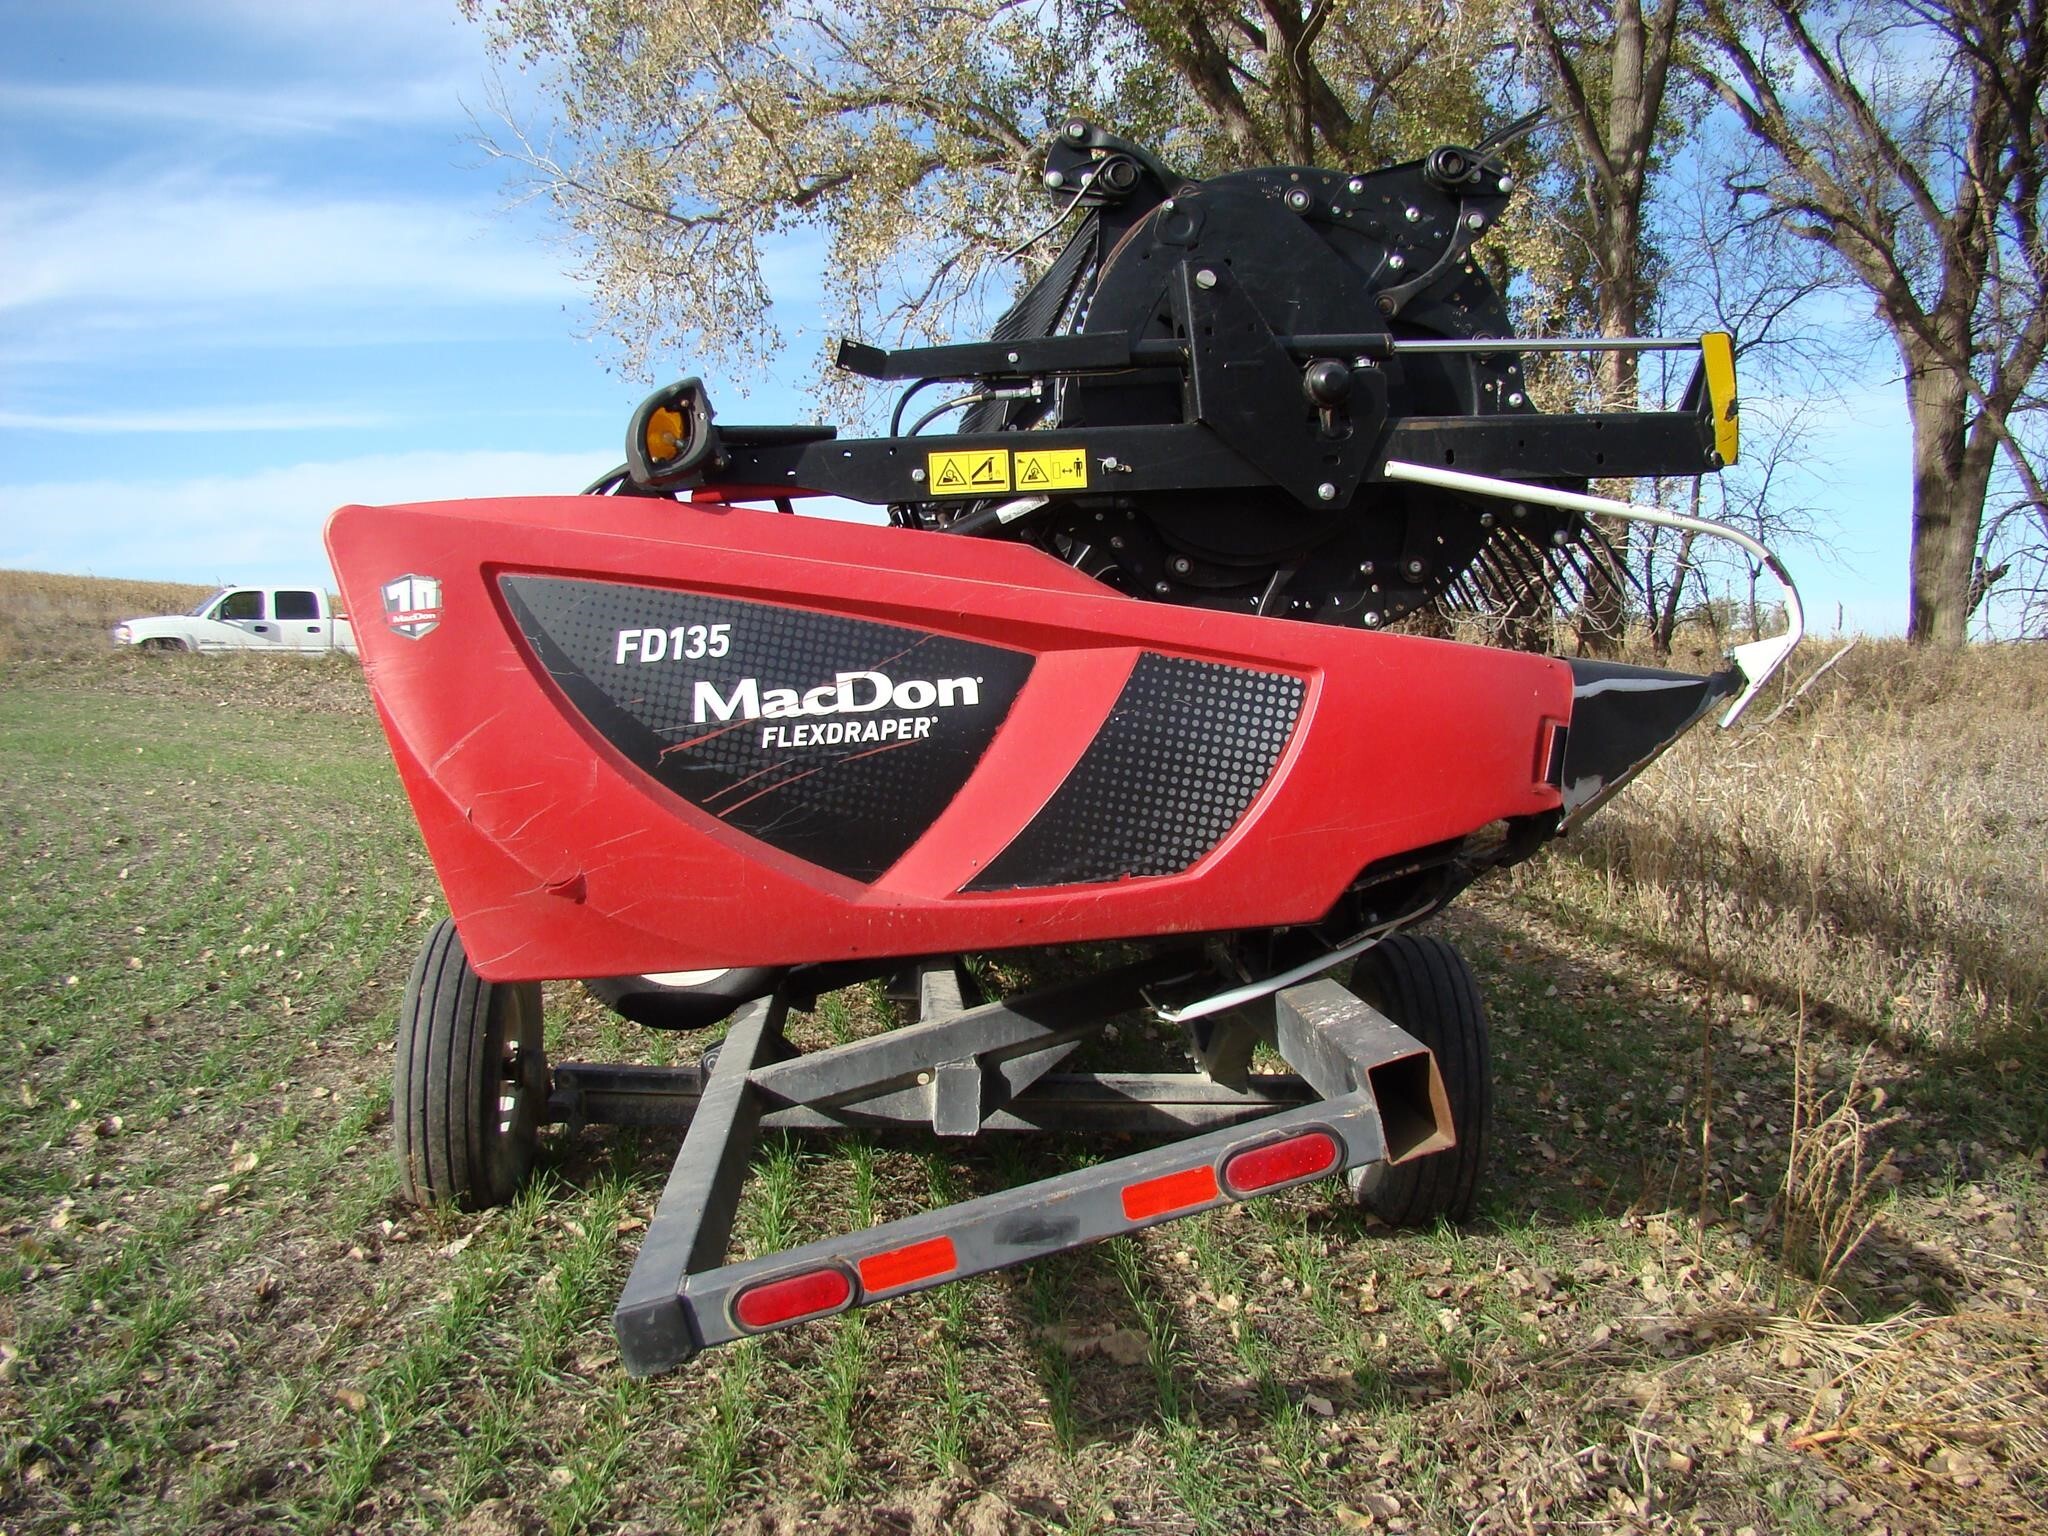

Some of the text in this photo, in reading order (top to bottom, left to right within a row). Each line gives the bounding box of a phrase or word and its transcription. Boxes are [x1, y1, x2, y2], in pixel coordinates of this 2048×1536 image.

[616, 624, 731, 664] FD135
[693, 671, 979, 723] MacDon
[761, 717, 931, 748] FLEXDRAPER
